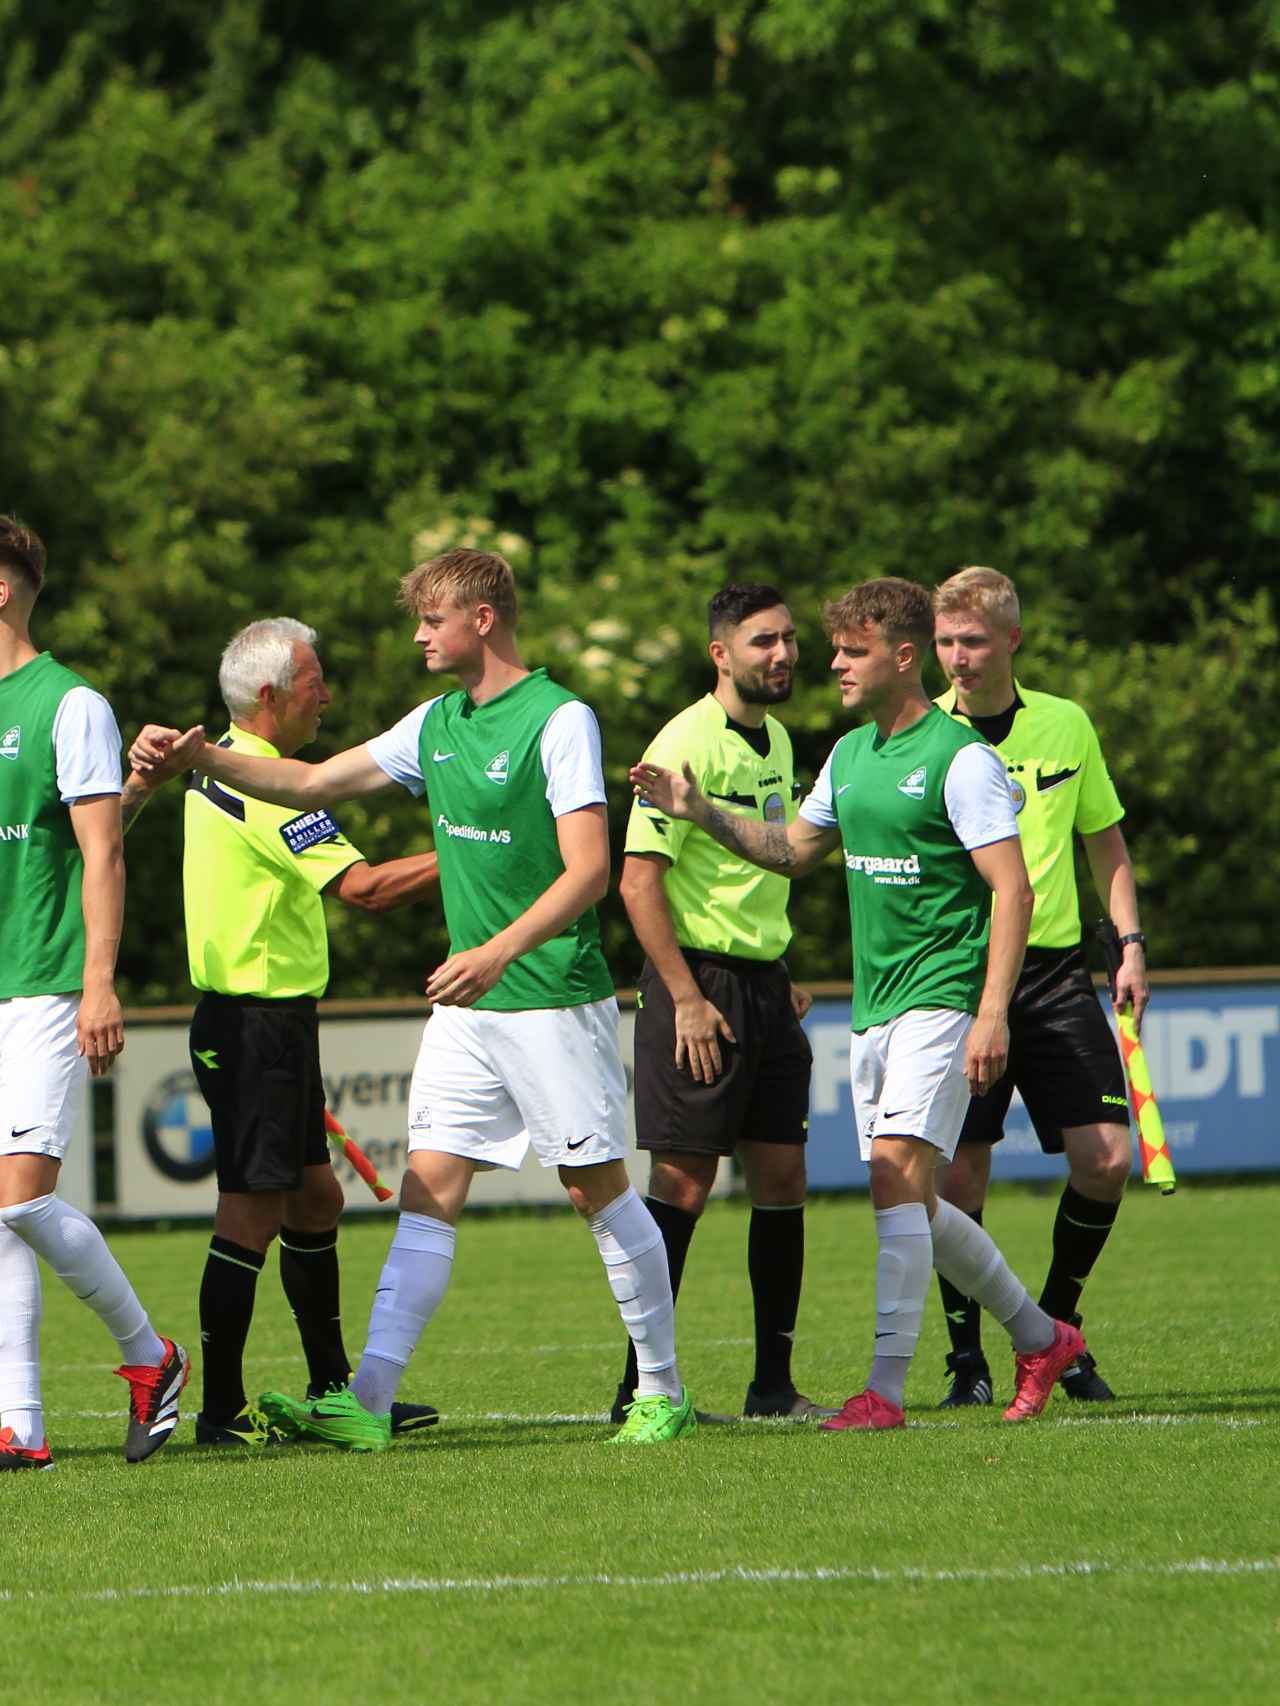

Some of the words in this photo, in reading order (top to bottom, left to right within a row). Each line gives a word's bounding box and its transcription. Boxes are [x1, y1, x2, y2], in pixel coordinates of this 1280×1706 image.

[283, 809, 328, 837] THIELE
[289, 819, 332, 846] BRILLER
[489, 829, 512, 844] A/S
